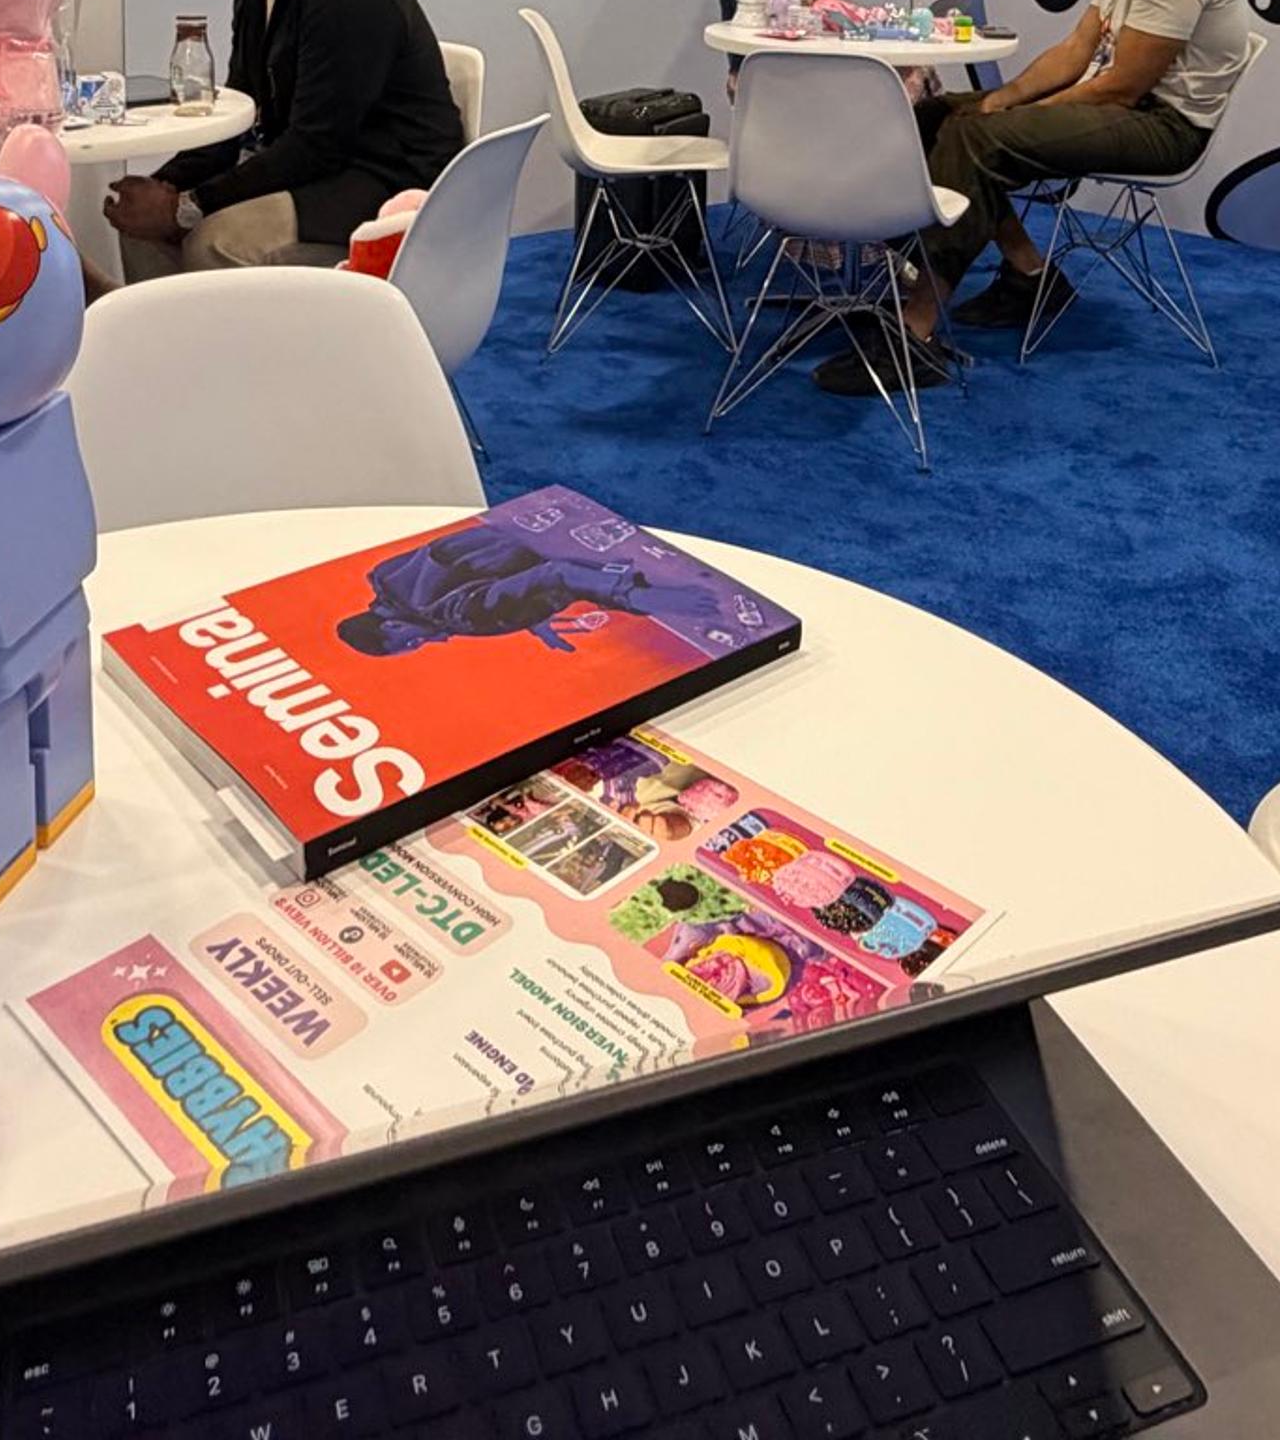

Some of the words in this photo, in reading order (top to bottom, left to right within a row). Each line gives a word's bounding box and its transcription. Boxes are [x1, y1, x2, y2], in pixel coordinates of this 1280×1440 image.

[391, 844, 418, 868] MOD
[415, 861, 475, 907] CONVERSION
[358, 851, 485, 946] DTC-LED
[274, 897, 311, 930] VIEWS
[474, 904, 501, 927] HIGH
[255, 937, 289, 967] DROPS
[308, 922, 355, 966] BILLION
[206, 937, 331, 1047] WEEKLY
[363, 972, 397, 1002] OVER
[509, 967, 556, 1005] MODEL
[578, 981, 615, 1010] purchase
[551, 1002, 629, 1065] NVERSION
[464, 1029, 519, 1076] ENGINE
[975, 1138, 1008, 1155] delete
[710, 1220, 725, 1237] 9
[645, 1240, 660, 1258] 8
[829, 1238, 843, 1256] P
[1051, 1247, 1086, 1265] return
[578, 1261, 589, 1279] 7
[509, 1283, 523, 1301] 6
[437, 1305, 451, 1324] 5
[630, 1302, 647, 1322] U
[1102, 1308, 1131, 1327] shift
[364, 1327, 377, 1344] 4
[560, 1325, 573, 1344] Y
[813, 1318, 830, 1336] L
[487, 1349, 500, 1368] T
[745, 1340, 762, 1360] K
[287, 1351, 300, 1371] 3
[412, 1374, 428, 1394] R
[678, 1365, 689, 1385] J
[207, 1376, 221, 1396] 2
[335, 1398, 349, 1420] E
[600, 1389, 619, 1411] H
[250, 1423, 271, 1440] W
[526, 1415, 543, 1436] G
[738, 1424, 759, 1440] M
